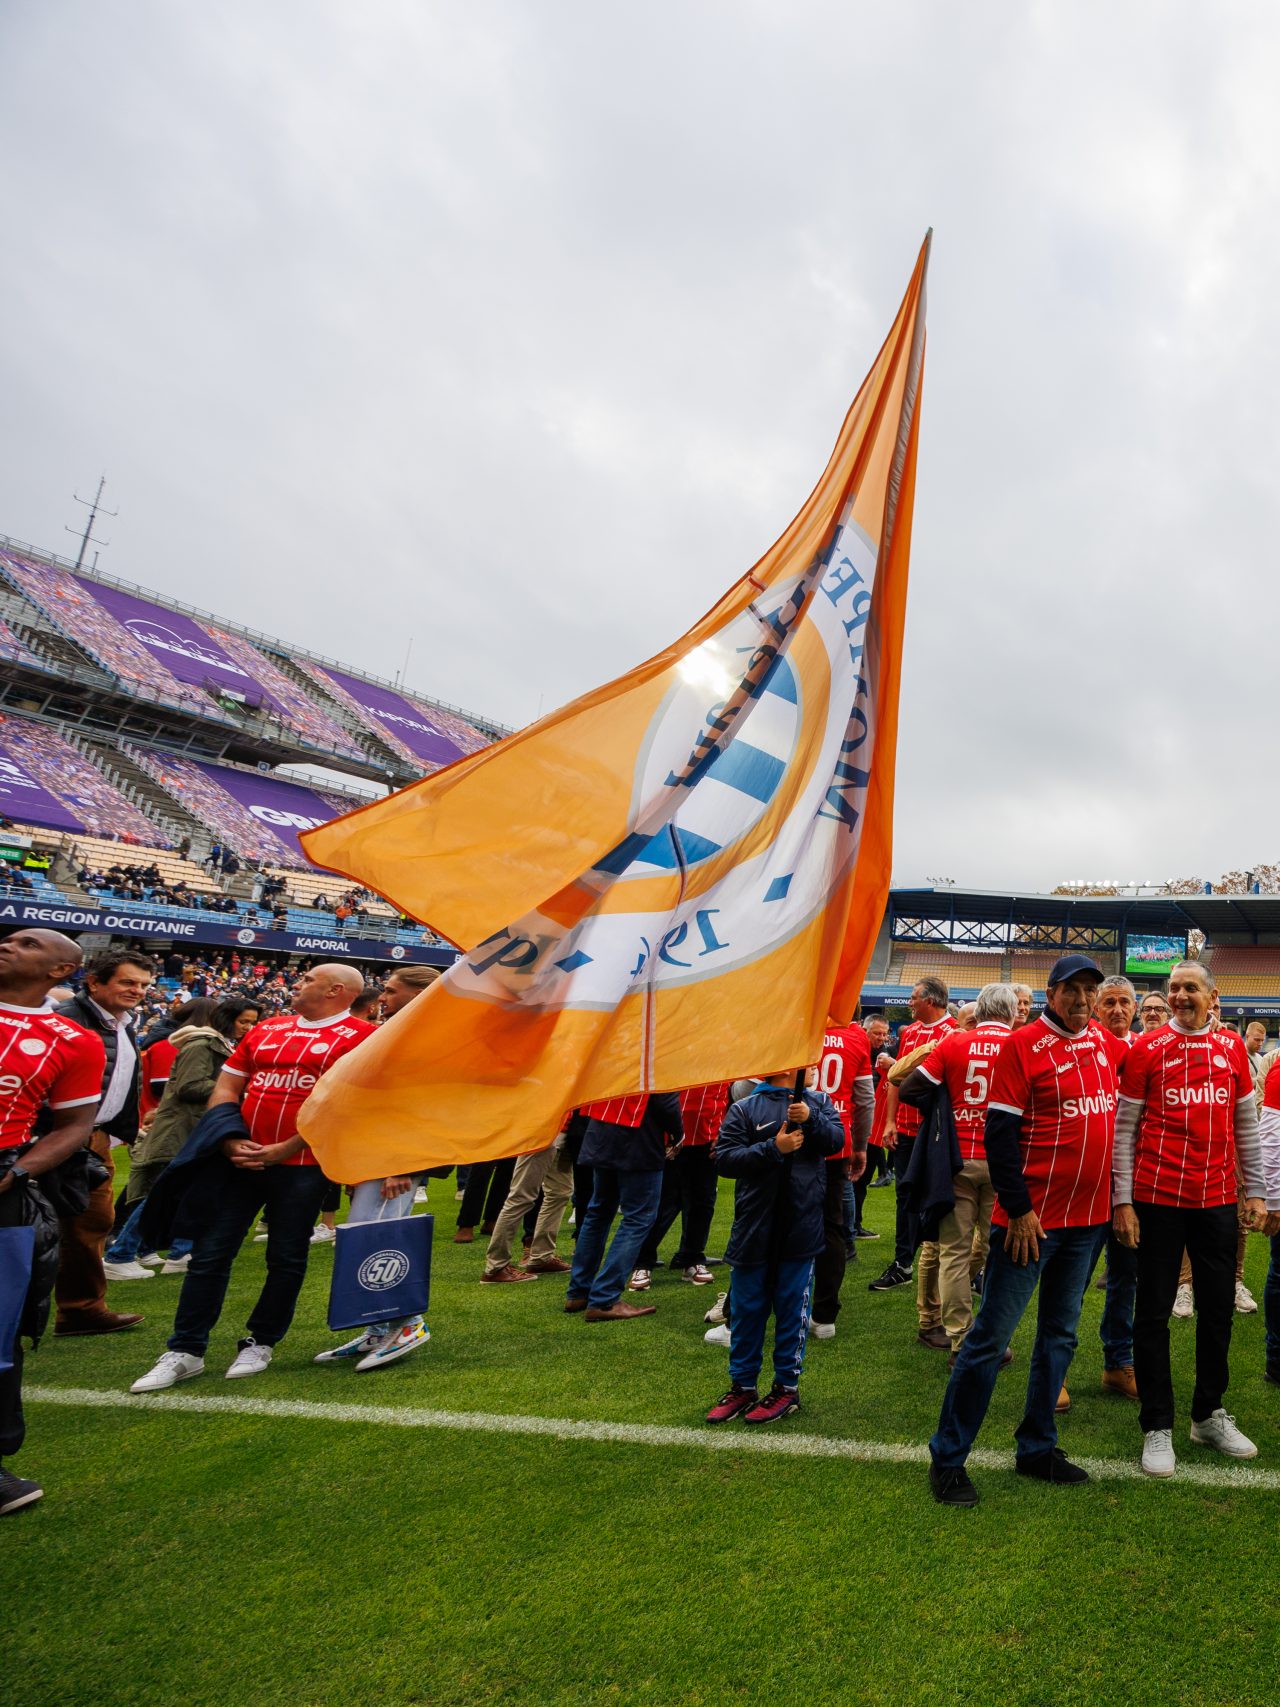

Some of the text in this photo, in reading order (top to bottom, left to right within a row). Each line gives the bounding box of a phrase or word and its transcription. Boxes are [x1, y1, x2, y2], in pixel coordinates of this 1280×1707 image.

[23, 906, 100, 928] REGION
[104, 915, 197, 936] OCCITANIE
[296, 937, 351, 952] KAPORAL
[253, 1069, 316, 1089] swile
[1062, 1089, 1115, 1118] swile
[1165, 1082, 1229, 1106] swile
[367, 1259, 400, 1282] 50
